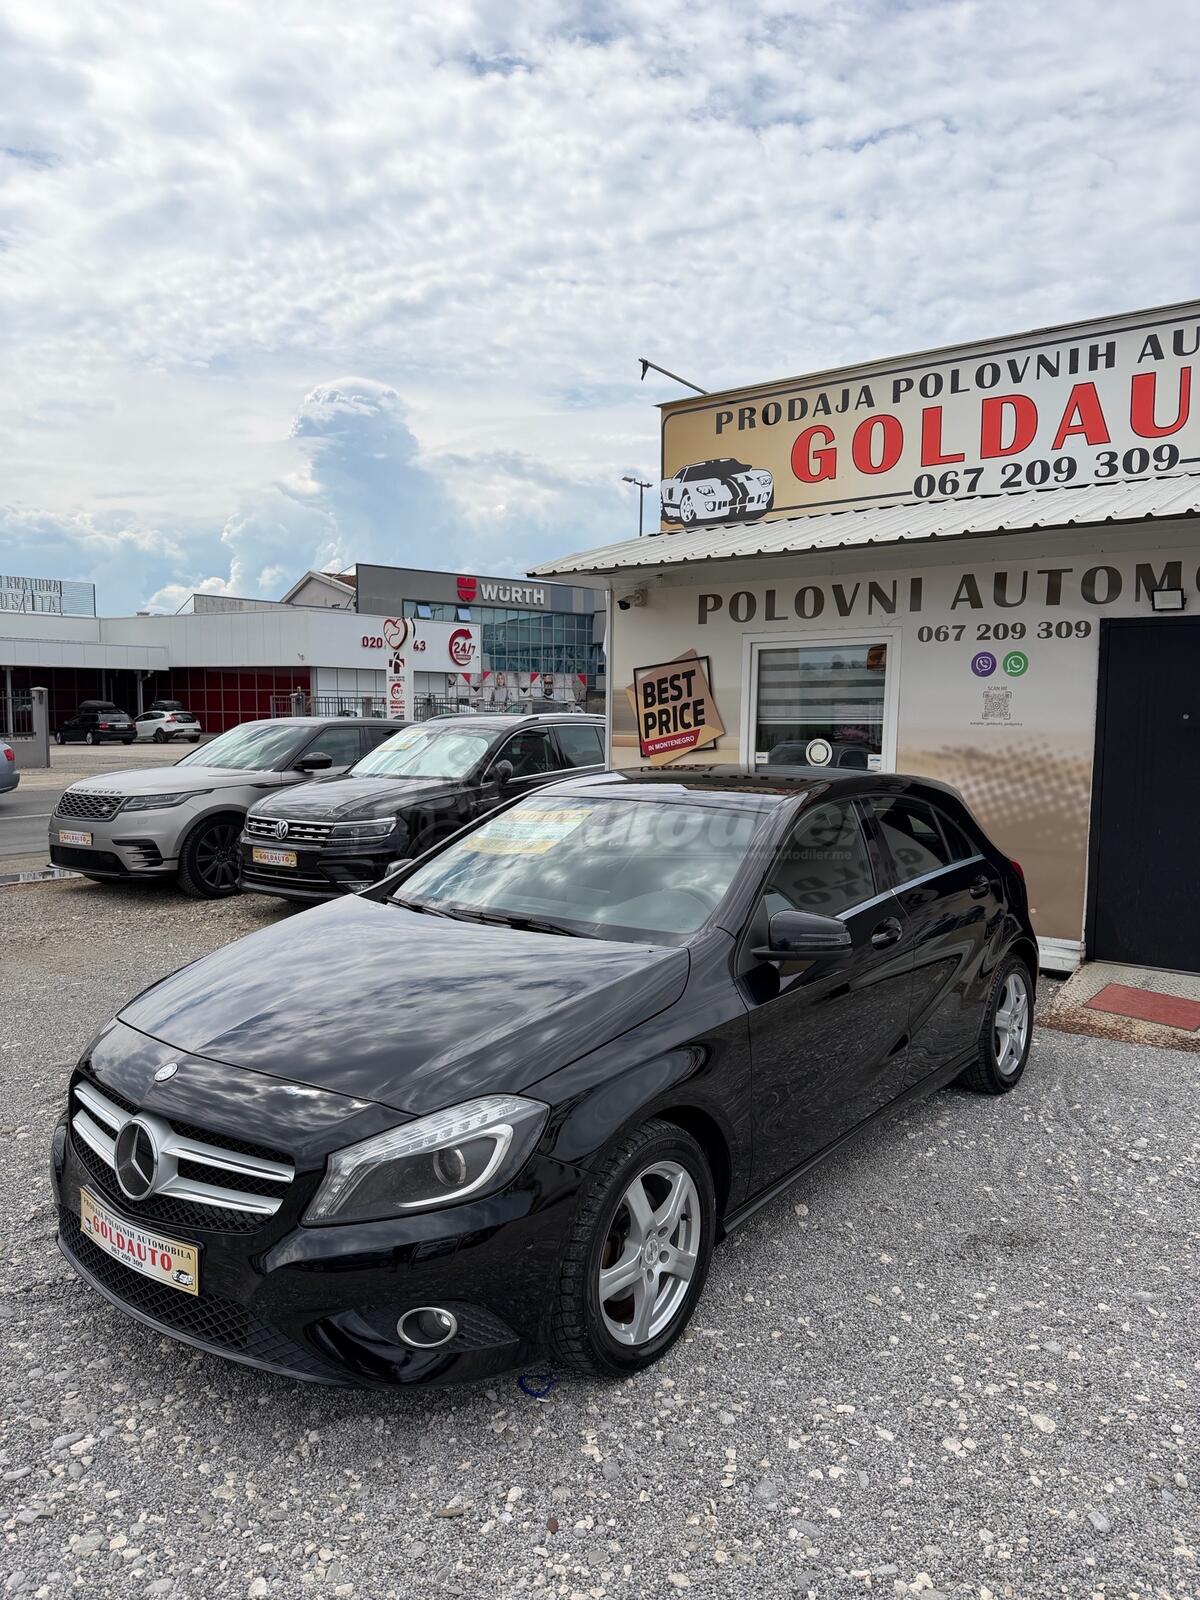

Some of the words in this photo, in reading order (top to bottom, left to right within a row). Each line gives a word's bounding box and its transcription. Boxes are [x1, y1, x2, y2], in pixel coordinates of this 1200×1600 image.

[716, 385, 875, 434] PRODAJA
[892, 341, 1116, 404] POLOVNIH
[791, 366, 1192, 484] GOLDAU
[913, 467, 985, 498] 067
[1000, 456, 1078, 489] 209
[1094, 443, 1180, 478] 309
[481, 583, 545, 605] WÜRTH
[698, 577, 923, 624] POLOVNI
[950, 561, 1200, 610] AUTOM
[361, 636, 383, 648] 020
[453, 641, 476, 655] 24/7
[917, 624, 967, 643] 067
[976, 622, 1027, 641] 209
[1037, 620, 1092, 640] 309
[643, 669, 696, 709] BEST
[643, 698, 706, 739] PRICE
[648, 744, 655, 752] IN
[655, 735, 695, 750] MONTENEGRO
[259, 852, 290, 863] GOLDAUTO
[93, 1215, 173, 1271] GOLDAUTO
[137, 1234, 192, 1260] AUTOMOBILA
